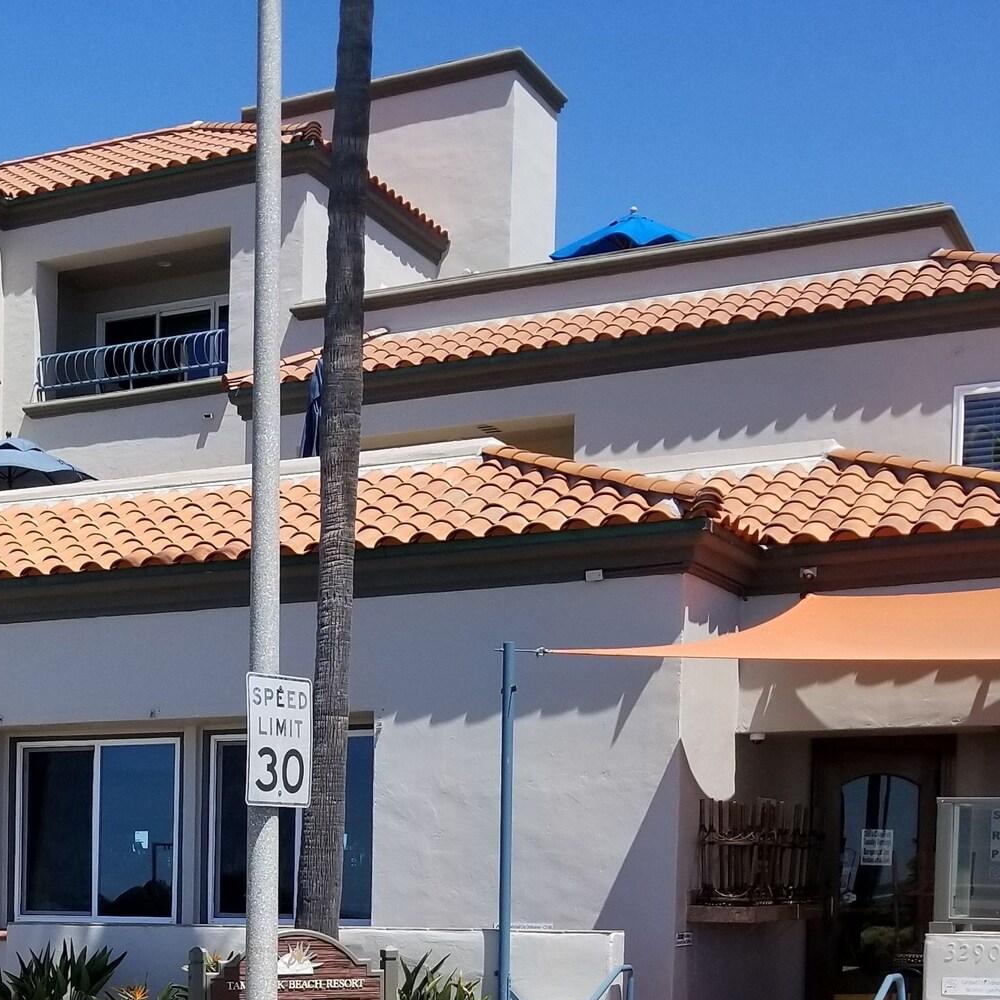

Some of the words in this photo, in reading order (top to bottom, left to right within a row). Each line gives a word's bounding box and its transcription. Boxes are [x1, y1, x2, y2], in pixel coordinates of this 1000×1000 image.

[252, 686, 308, 710] SPEED
[258, 716, 303, 738] LIMIT
[255, 746, 305, 794] 30
[289, 979, 323, 989] BEACH
[326, 978, 365, 989] RESORT
